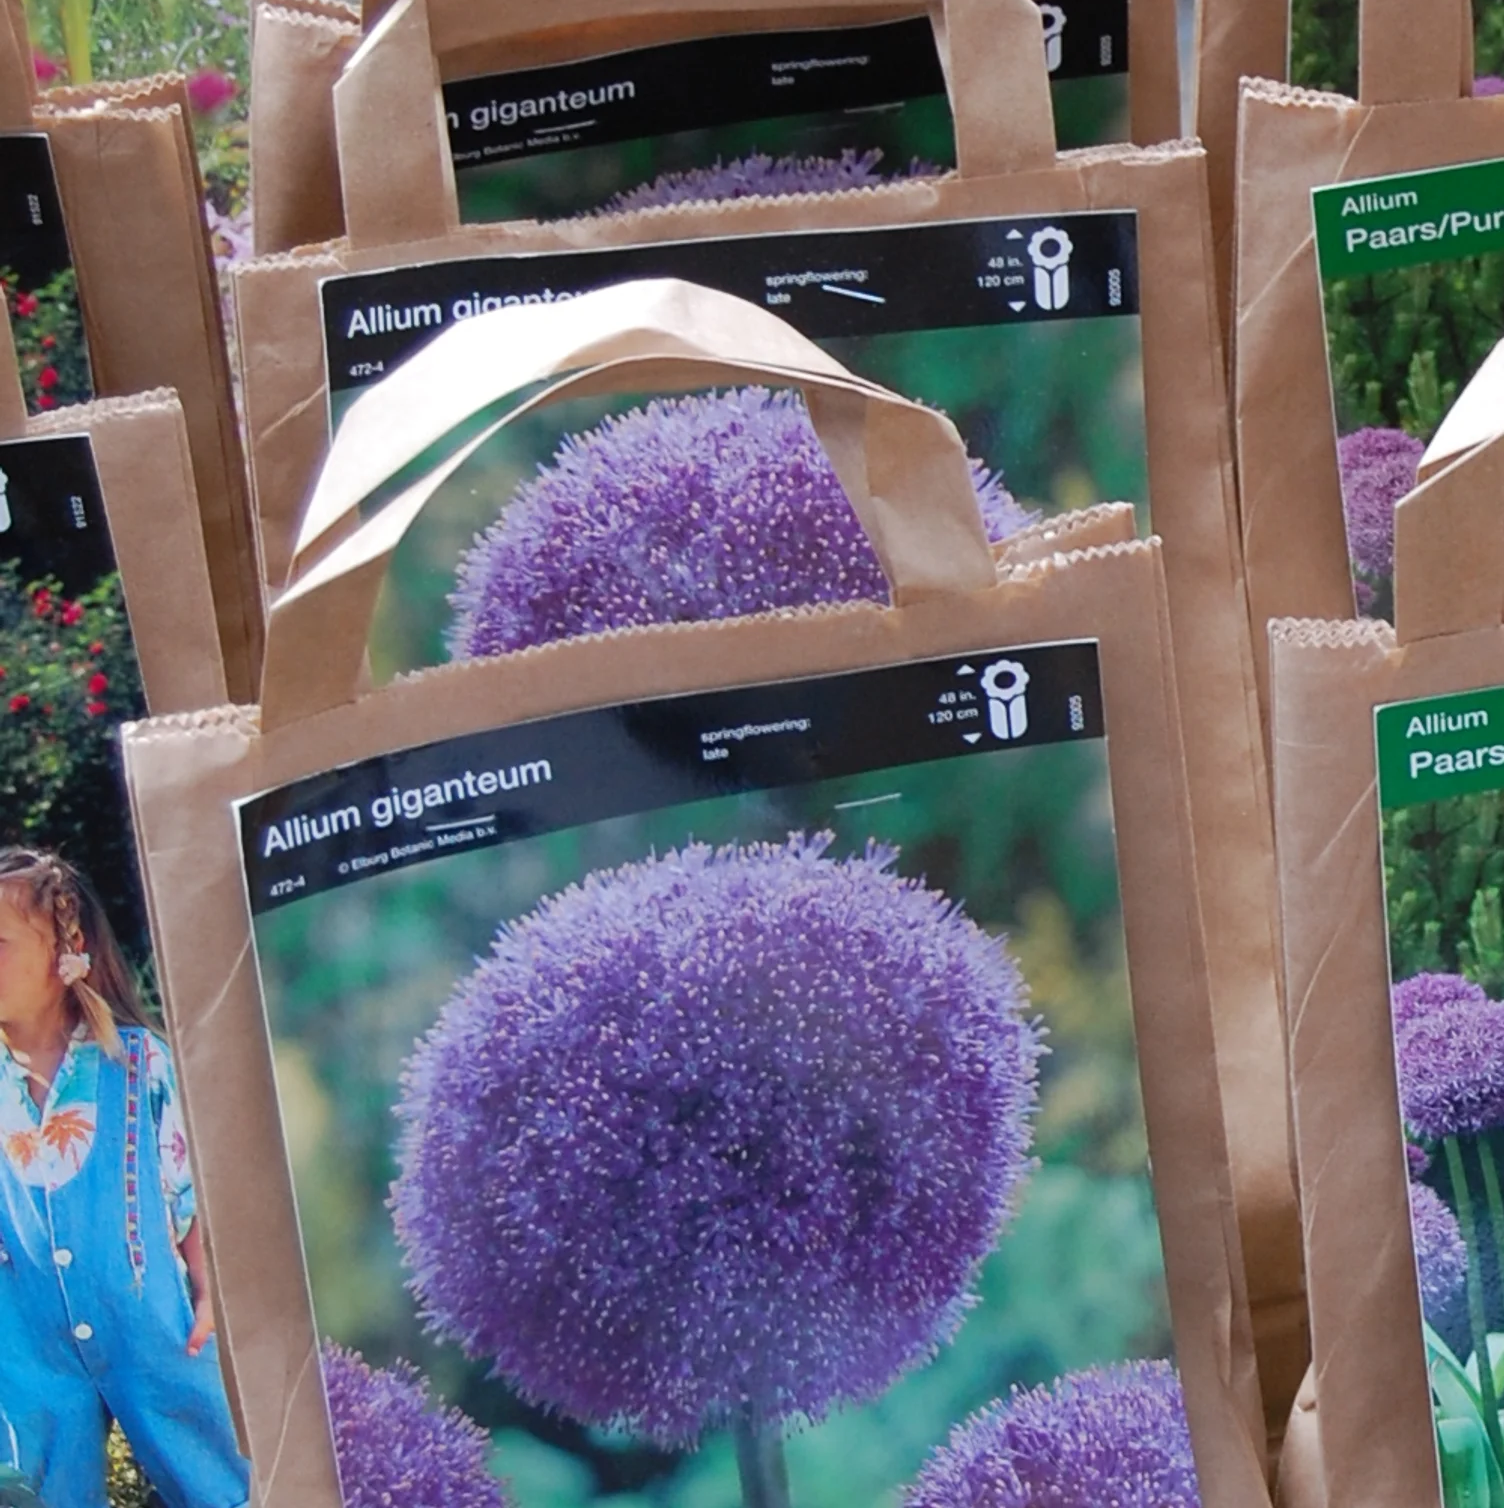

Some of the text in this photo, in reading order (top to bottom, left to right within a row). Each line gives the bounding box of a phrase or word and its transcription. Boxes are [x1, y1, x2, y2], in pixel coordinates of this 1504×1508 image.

[470, 80, 636, 131] giganteum
[1341, 190, 1419, 217] Allium
[987, 255, 1024, 269] 48 in.
[765, 268, 869, 290] springflowering:
[977, 274, 1025, 289] 120 cm
[766, 291, 791, 305] late
[347, 301, 443, 339] Allium
[349, 360, 385, 378] 472-4
[938, 689, 977, 705] 48 in.
[927, 708, 979, 725] 120 cm
[1406, 708, 1490, 739] Allium
[700, 717, 811, 745] springflowering:
[702, 747, 730, 762] late
[264, 759, 552, 858] Allium giganteum
[351, 851, 389, 871] Elburg
[390, 839, 435, 860] Botanic
[436, 829, 475, 847] Media
[475, 825, 498, 838] b.v.
[269, 875, 306, 897] 472-4
